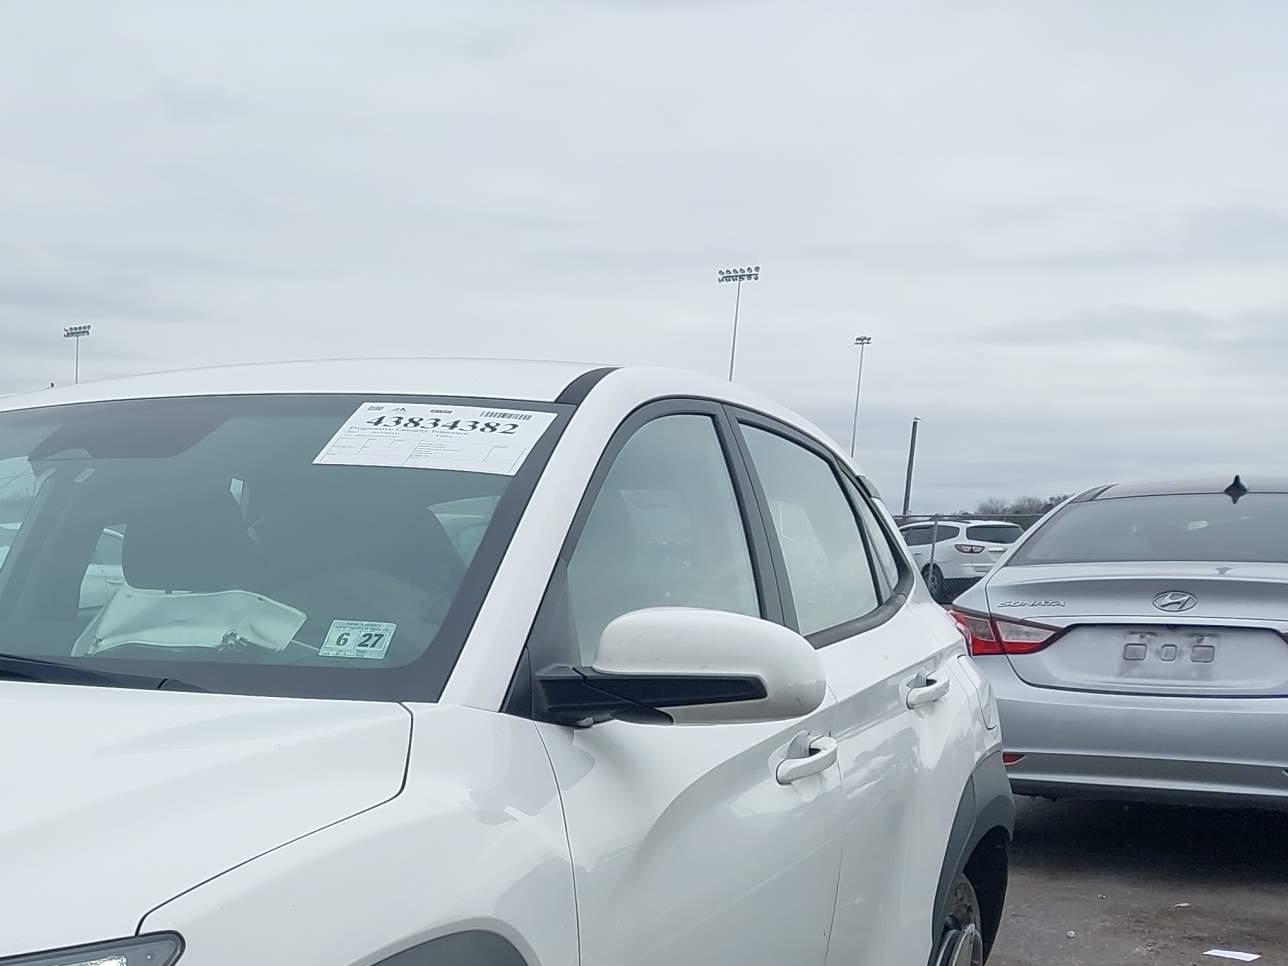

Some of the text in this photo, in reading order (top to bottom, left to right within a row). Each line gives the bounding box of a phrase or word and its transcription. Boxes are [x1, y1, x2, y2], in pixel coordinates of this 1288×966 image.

[366, 416, 519, 435] 43834382
[997, 599, 1066, 608] SONATA
[336, 632, 385, 648] 6 27
